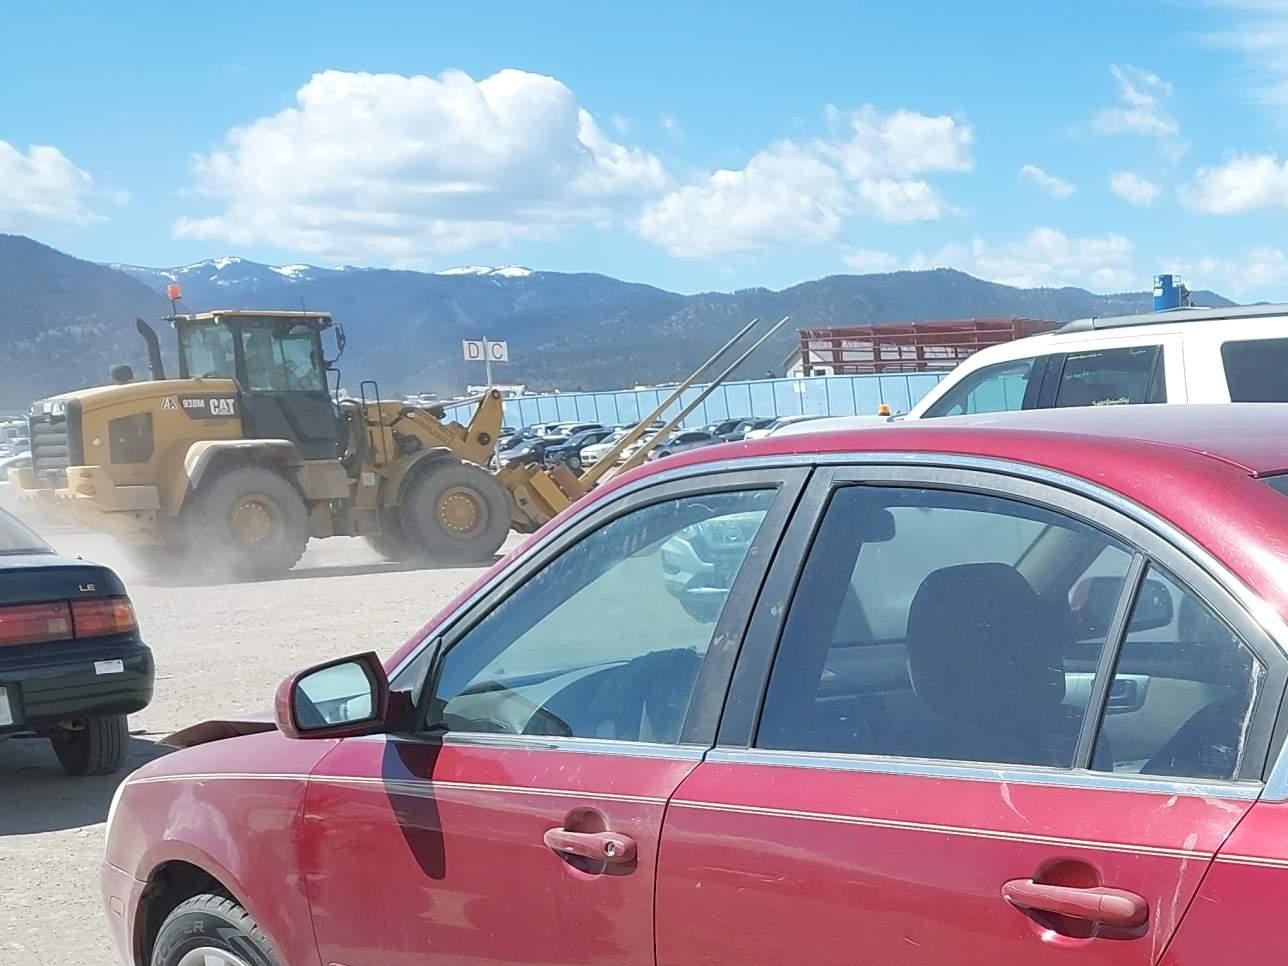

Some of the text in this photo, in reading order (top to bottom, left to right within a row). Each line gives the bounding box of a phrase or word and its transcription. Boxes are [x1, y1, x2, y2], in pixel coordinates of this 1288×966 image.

[468, 342, 504, 360] D C
[209, 398, 236, 416] CAT
[78, 583, 97, 592] LE
